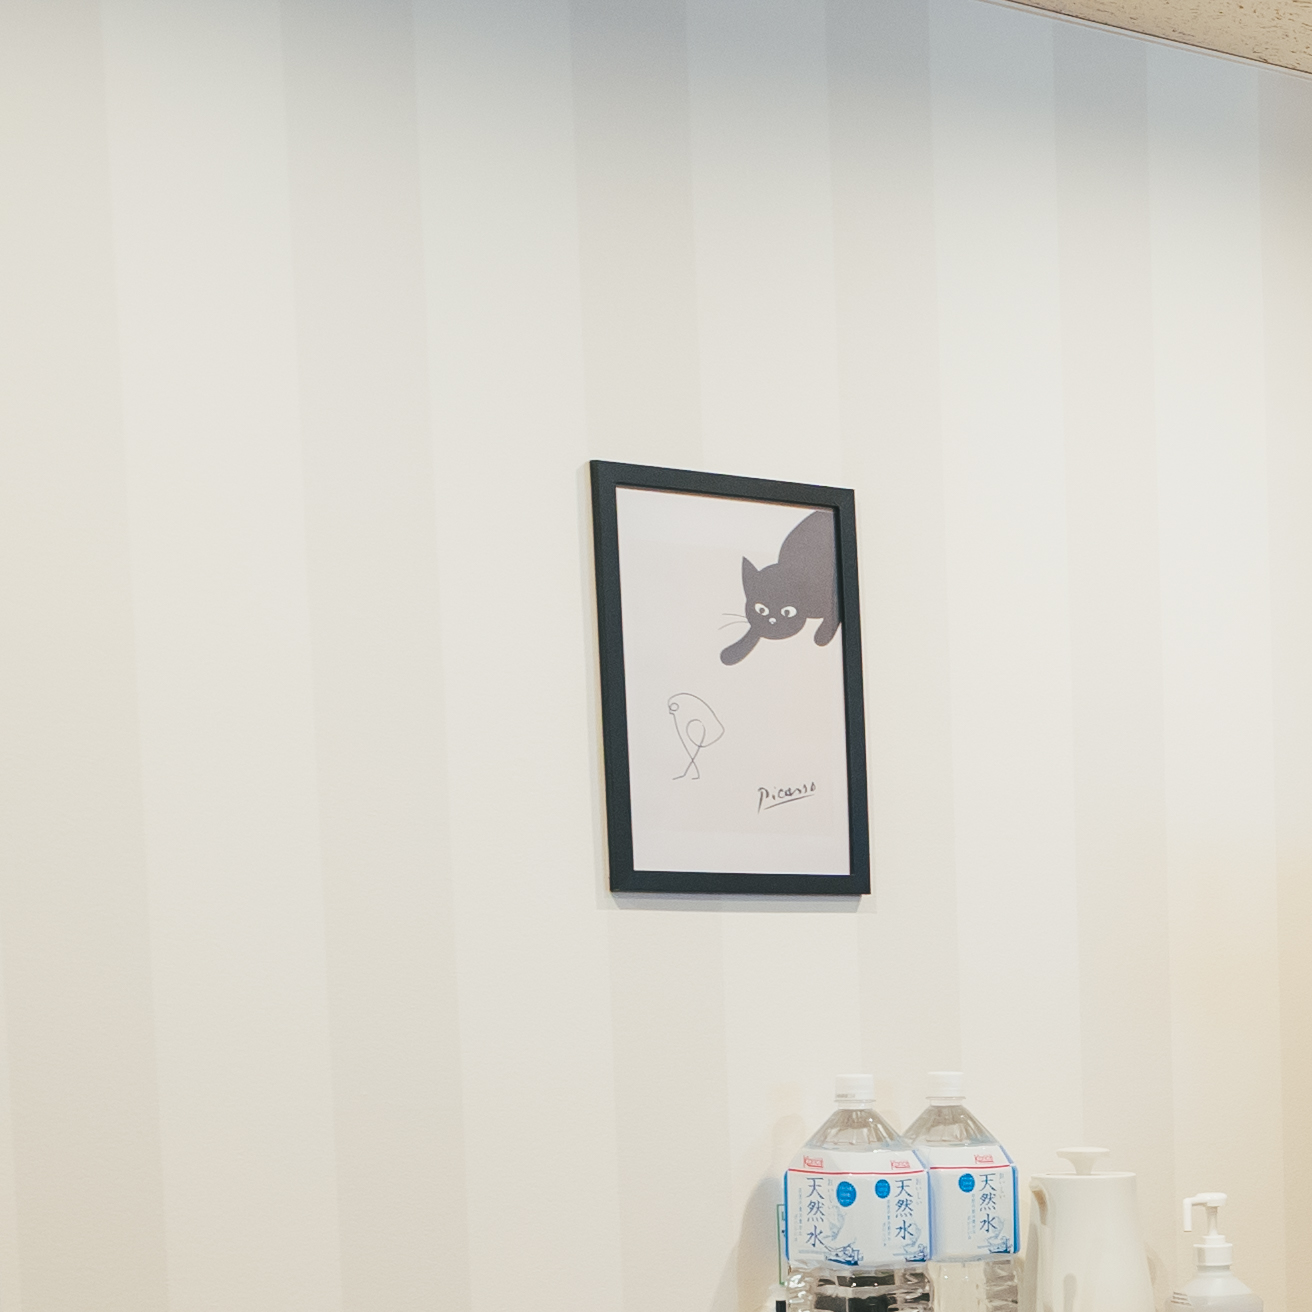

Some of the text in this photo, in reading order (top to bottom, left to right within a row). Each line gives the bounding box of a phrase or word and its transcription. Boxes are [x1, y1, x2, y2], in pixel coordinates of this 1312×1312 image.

[806, 1177, 825, 1248] 天然水
[894, 1178, 914, 1240] 天然水
[979, 1173, 998, 1233] 天然水
